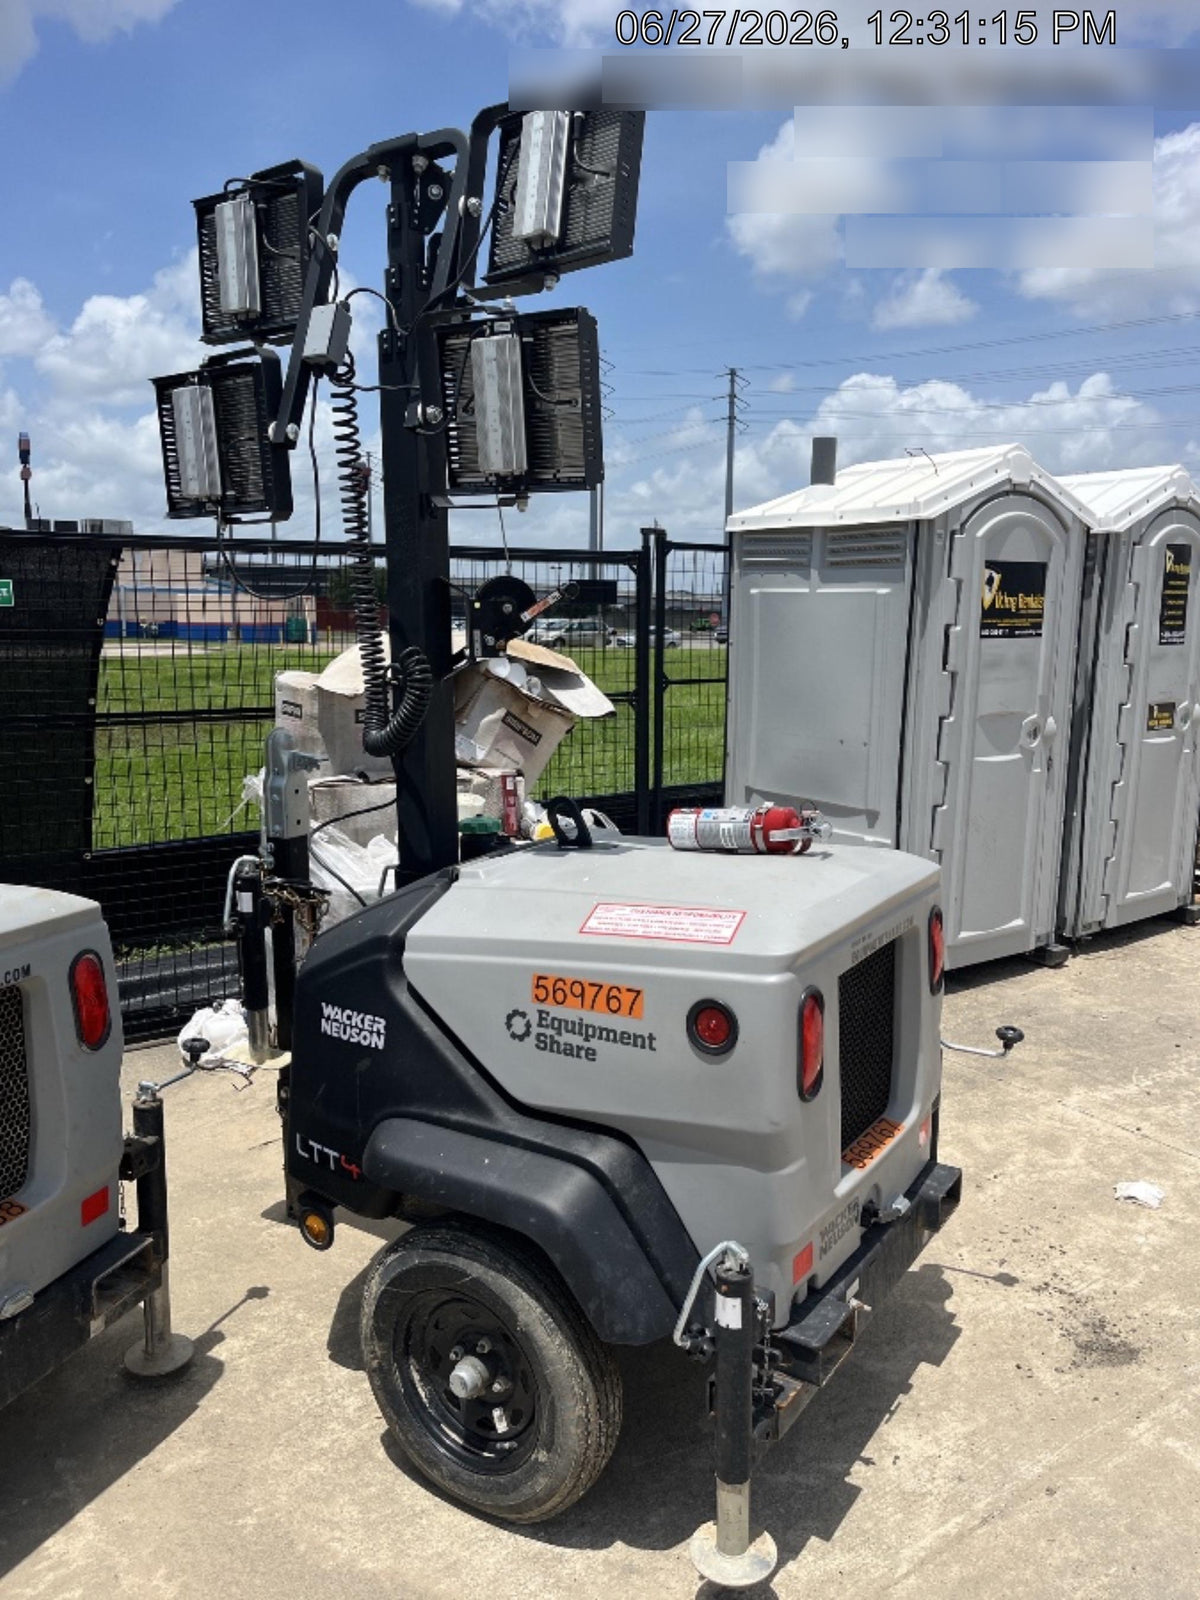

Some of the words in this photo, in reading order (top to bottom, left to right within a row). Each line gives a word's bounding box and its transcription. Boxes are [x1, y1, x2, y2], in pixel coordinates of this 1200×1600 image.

[534, 975, 643, 1016] 569767
[321, 1002, 386, 1034] WACKER
[321, 1018, 386, 1050] NEUSON
[536, 1009, 657, 1051] Equipment
[534, 1032, 598, 1062] Share
[296, 1132, 361, 1180] LTT4
[841, 1117, 901, 1169] 569767
